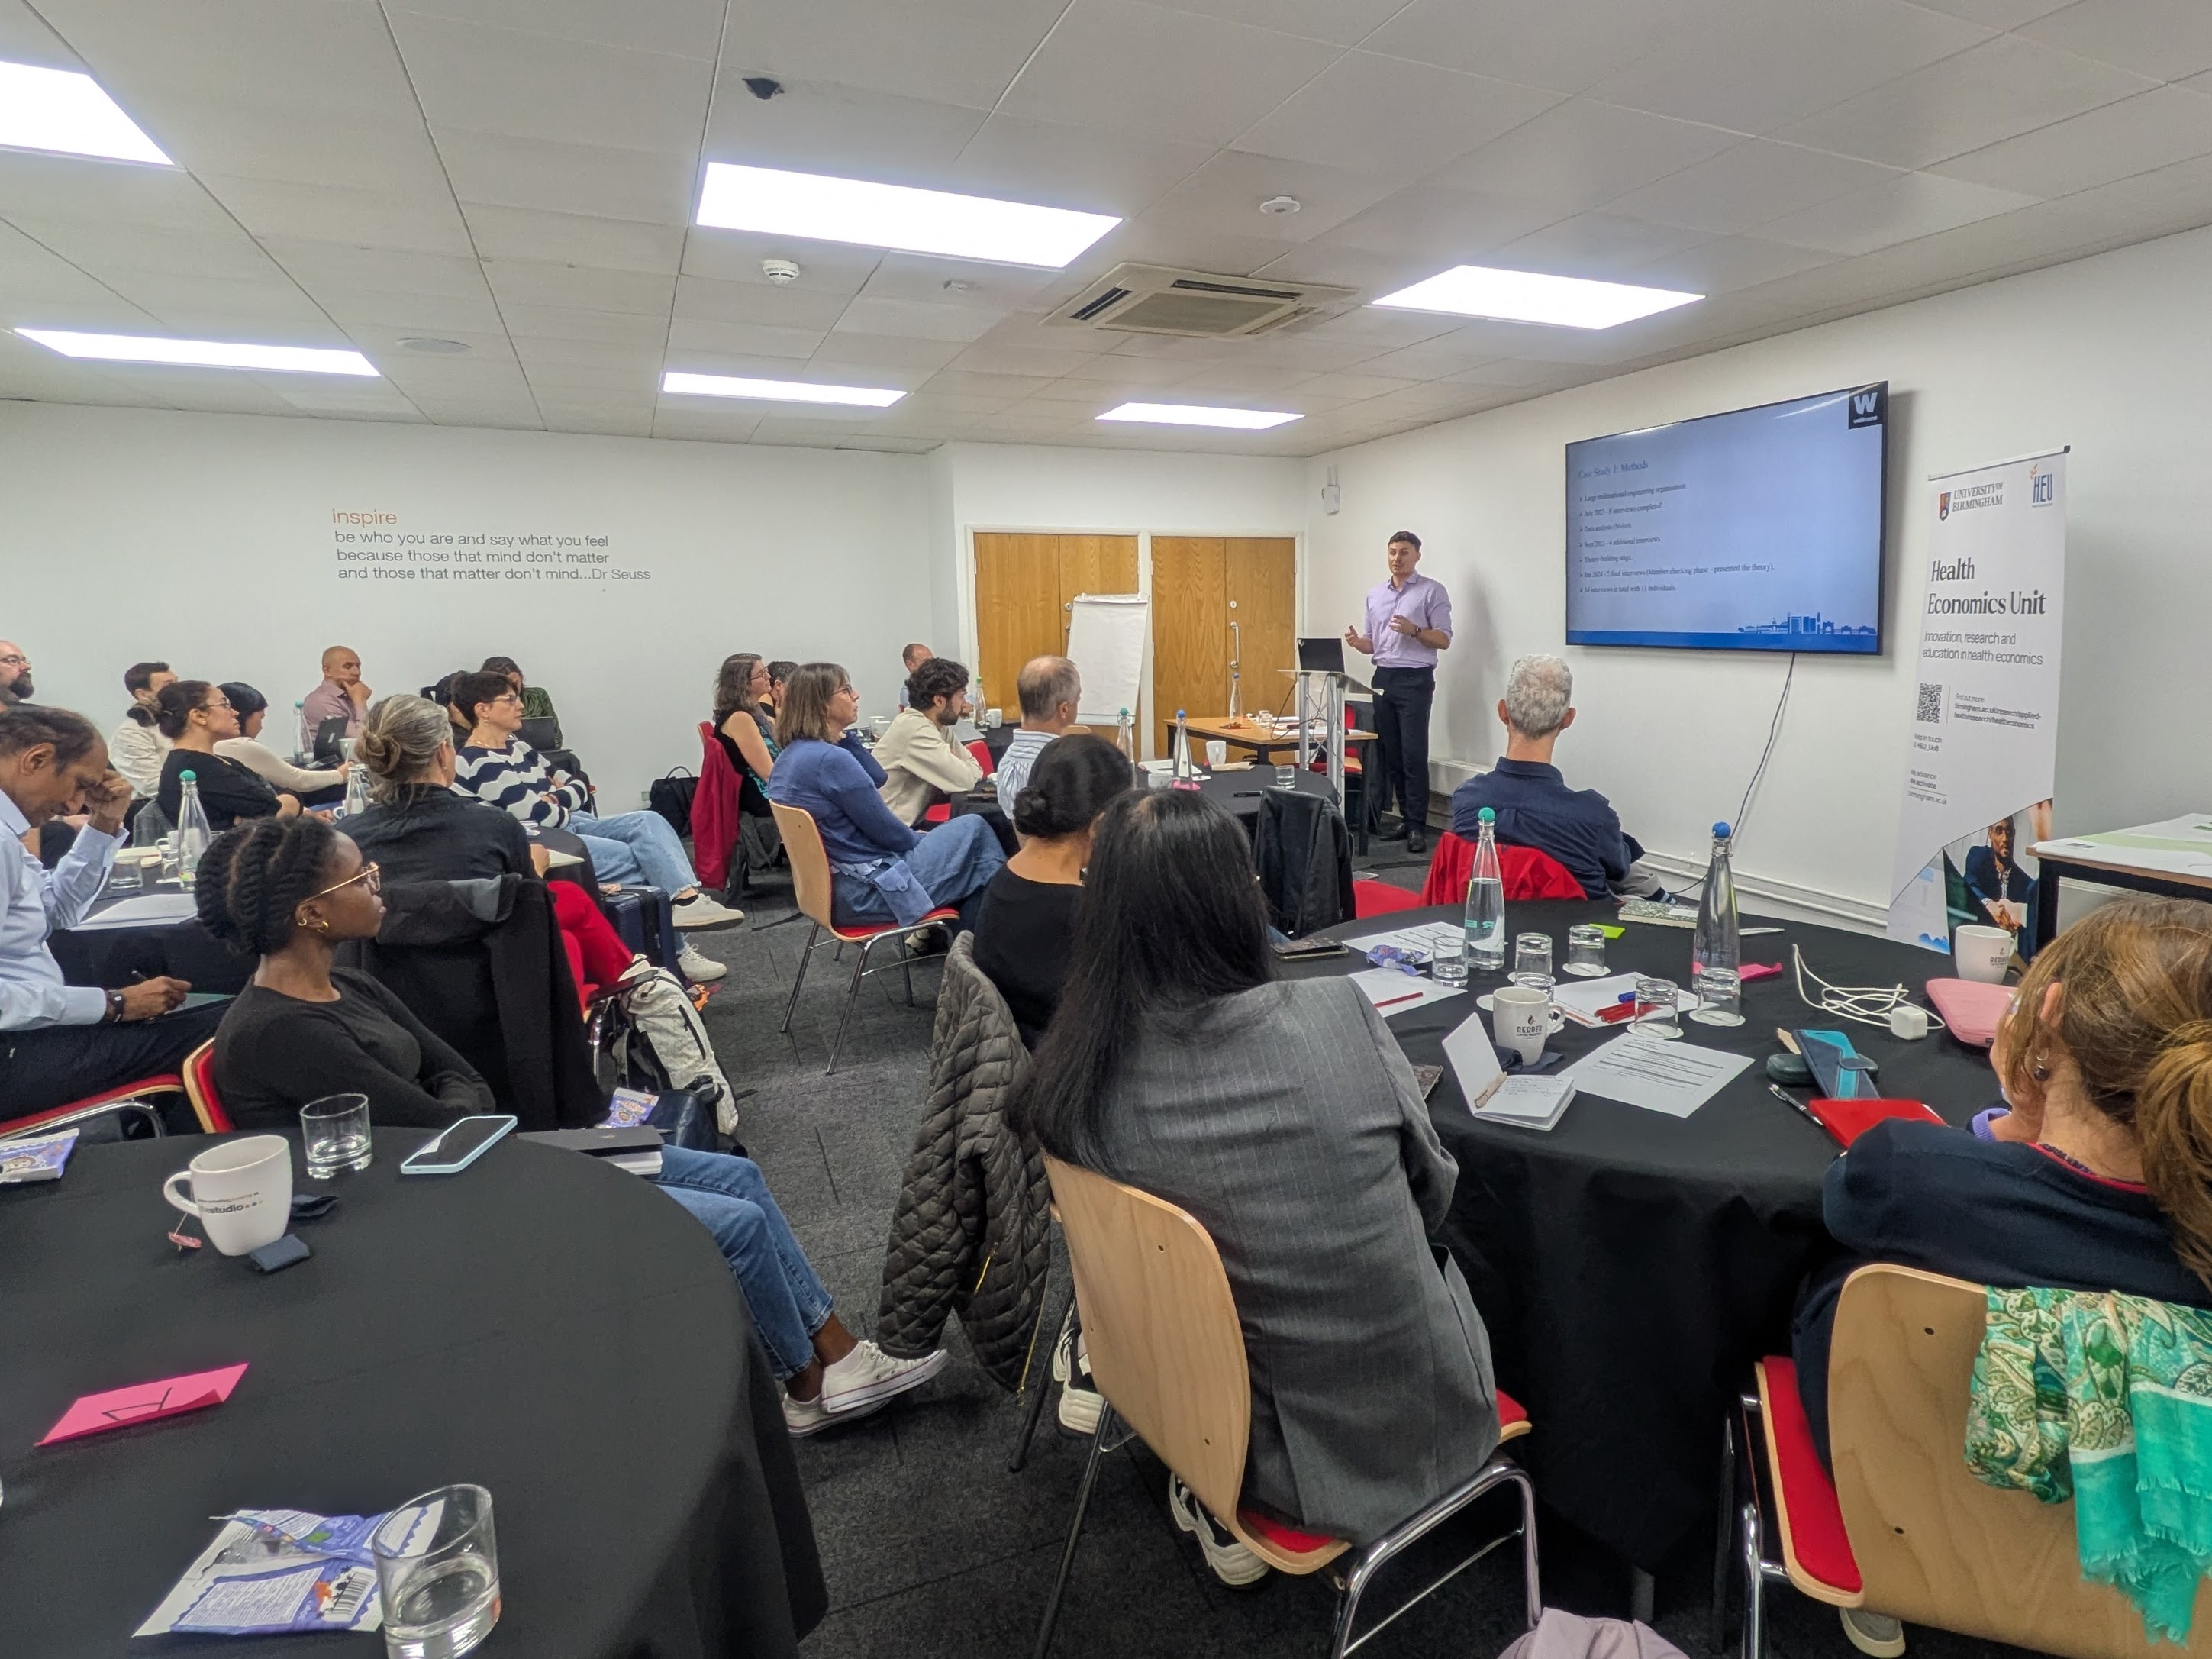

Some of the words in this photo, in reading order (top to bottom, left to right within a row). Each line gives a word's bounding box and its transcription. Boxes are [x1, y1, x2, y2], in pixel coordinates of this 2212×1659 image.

[1620, 460, 1649, 472] Methods
[1953, 483, 1996, 500] UNIVERSITY
[2032, 473, 2053, 503] HEU
[1952, 495, 2004, 512] BIRMINGHAM
[332, 508, 397, 528] inspire
[335, 531, 356, 543] be
[360, 531, 393, 544] who
[398, 534, 426, 546] you
[430, 534, 453, 544] are
[458, 534, 485, 545] and
[490, 536, 514, 547] say
[518, 534, 553, 546] what
[556, 537, 582, 548] you
[585, 535, 608, 547] feel
[337, 548, 403, 561] because
[408, 549, 450, 562] those
[453, 550, 482, 563] that
[486, 550, 521, 563] mind
[526, 551, 563, 563] don't
[566, 552, 610, 563] matter
[338, 567, 368, 579] and
[372, 567, 416, 579] those
[421, 567, 449, 579] that
[453, 568, 501, 579] matter
[505, 568, 541, 579] don't
[611, 569, 651, 579] Seuss
[1694, 566, 1709, 575] phase
[1714, 564, 1740, 573] presented
[1930, 557, 1975, 582] Health
[1927, 589, 2007, 615] Economics
[2010, 589, 2047, 615] Unit
[1924, 631, 1963, 644] Innovation,
[1964, 632, 2000, 644] research
[2001, 633, 2016, 645] and
[1923, 648, 1959, 660] education
[1960, 648, 1967, 660] in
[1967, 649, 1994, 662] health
[1995, 652, 2043, 665] economics
[1928, 734, 1943, 743] touch
